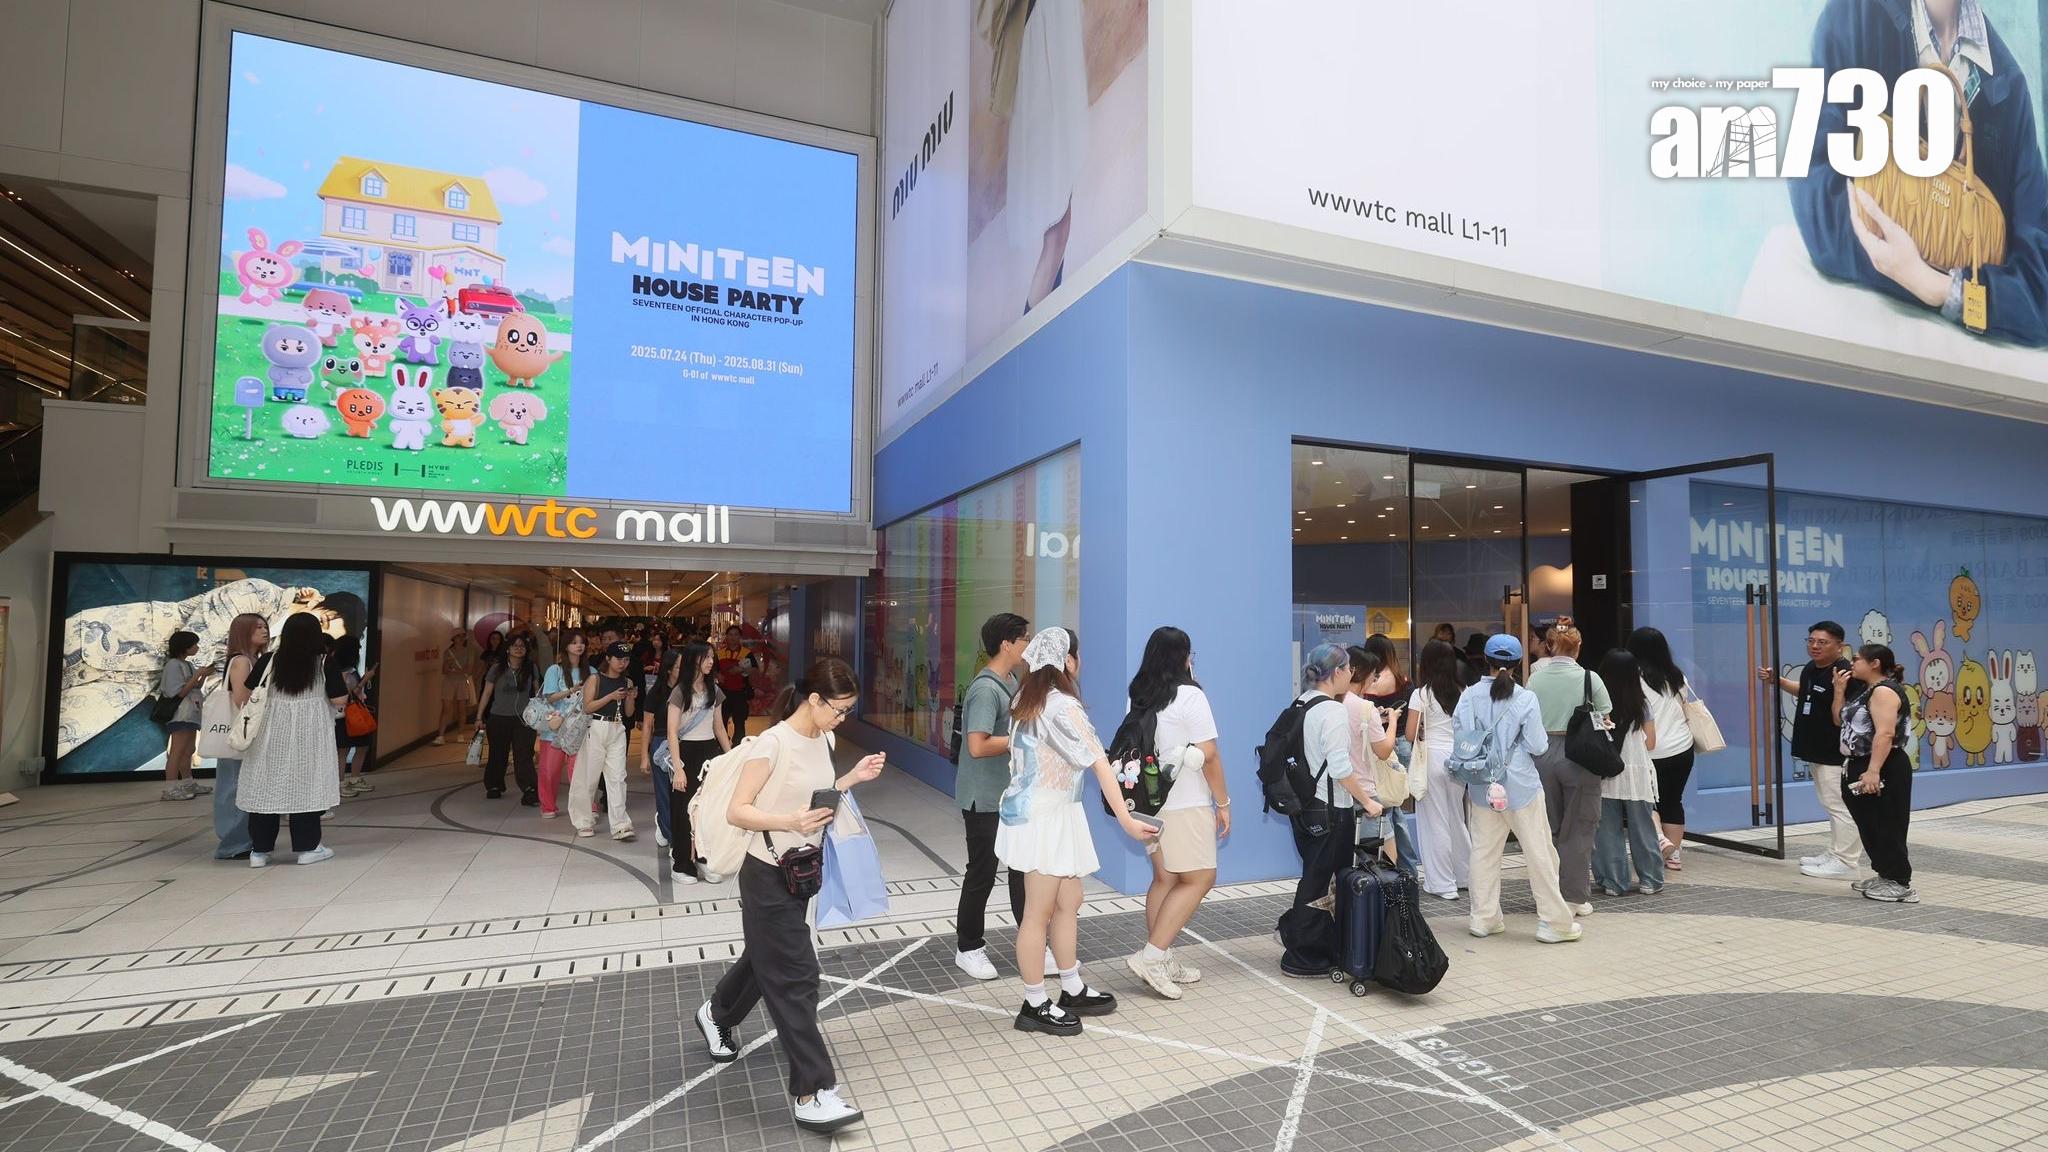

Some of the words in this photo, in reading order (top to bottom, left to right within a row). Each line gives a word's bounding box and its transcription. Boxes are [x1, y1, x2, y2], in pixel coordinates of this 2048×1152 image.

[1308, 188, 1397, 223] wwwtc
[1406, 211, 1454, 236] mall
[1462, 218, 1507, 247] L1-11
[612, 231, 825, 296] MINITEEN
[632, 275, 719, 304] HOUSE
[727, 288, 804, 315] PARTY
[632, 298, 684, 312] SEVENTEEN
[685, 305, 722, 317] OFFICIAL
[724, 310, 773, 323] CHARACTER
[774, 316, 804, 327] POP-UP
[691, 314, 700, 322] IN
[701, 316, 725, 326] HONG
[726, 319, 750, 329] KONG
[631, 344, 687, 362] 2025.07.24
[689, 351, 717, 367] (Thu)
[724, 355, 777, 372] 2025.08.31
[778, 360, 804, 376] (Sun)
[701, 370, 709, 380] of
[711, 373, 738, 384] wwwtc
[738, 374, 755, 385] mall
[346, 460, 383, 471] PLEDIS
[370, 498, 599, 539] wwwtc
[615, 505, 730, 543] mall
[1690, 517, 1844, 568] MINITEEN
[1777, 570, 1830, 595] PARTY
[1315, 613, 1356, 625] MINITEEN
